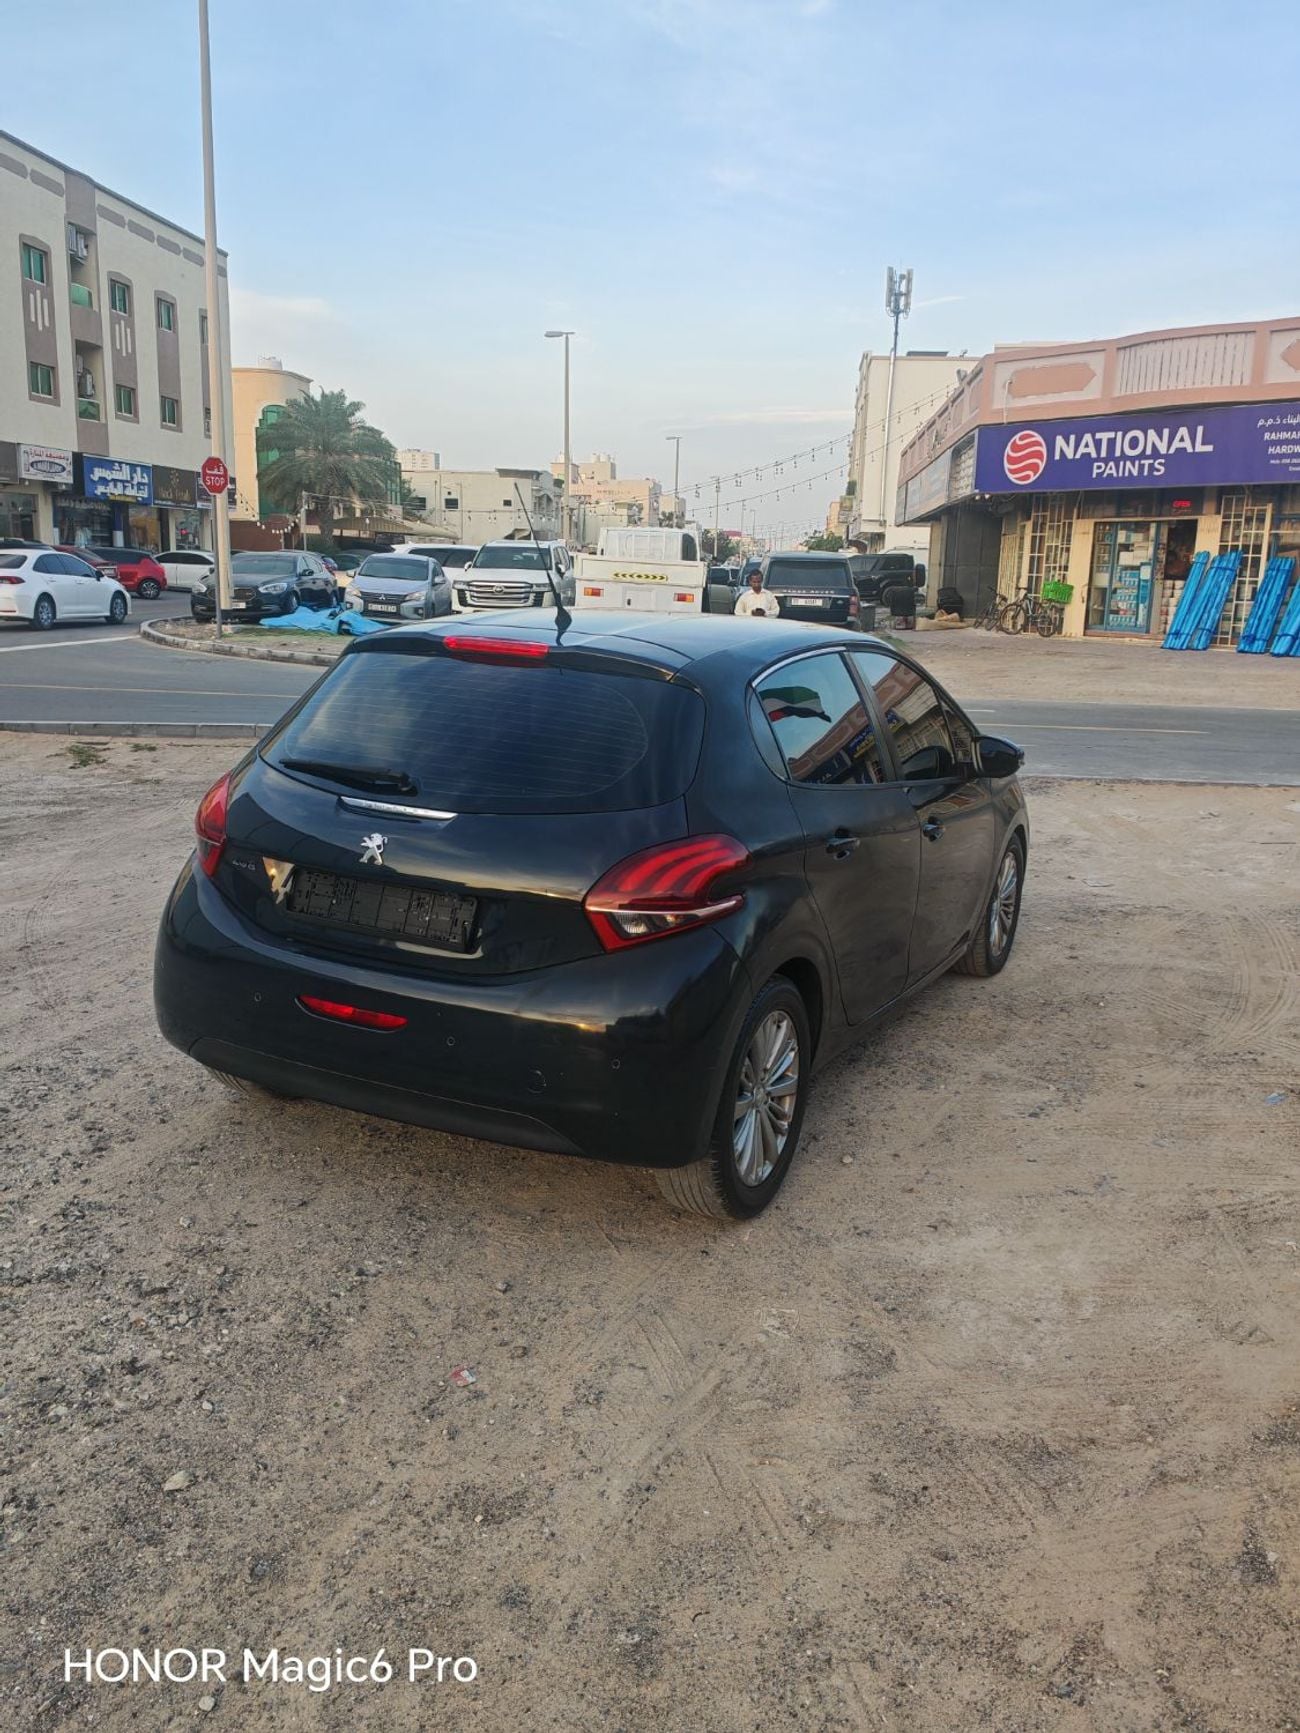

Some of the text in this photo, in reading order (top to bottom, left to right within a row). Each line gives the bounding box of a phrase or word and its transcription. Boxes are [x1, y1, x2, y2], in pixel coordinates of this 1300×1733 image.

[1054, 425, 1214, 461] NATIONAL
[90, 462, 149, 485] دار الشمس
[206, 464, 224, 474] قف
[1092, 459, 1165, 478] PAINTS
[205, 476, 225, 486] STOP
